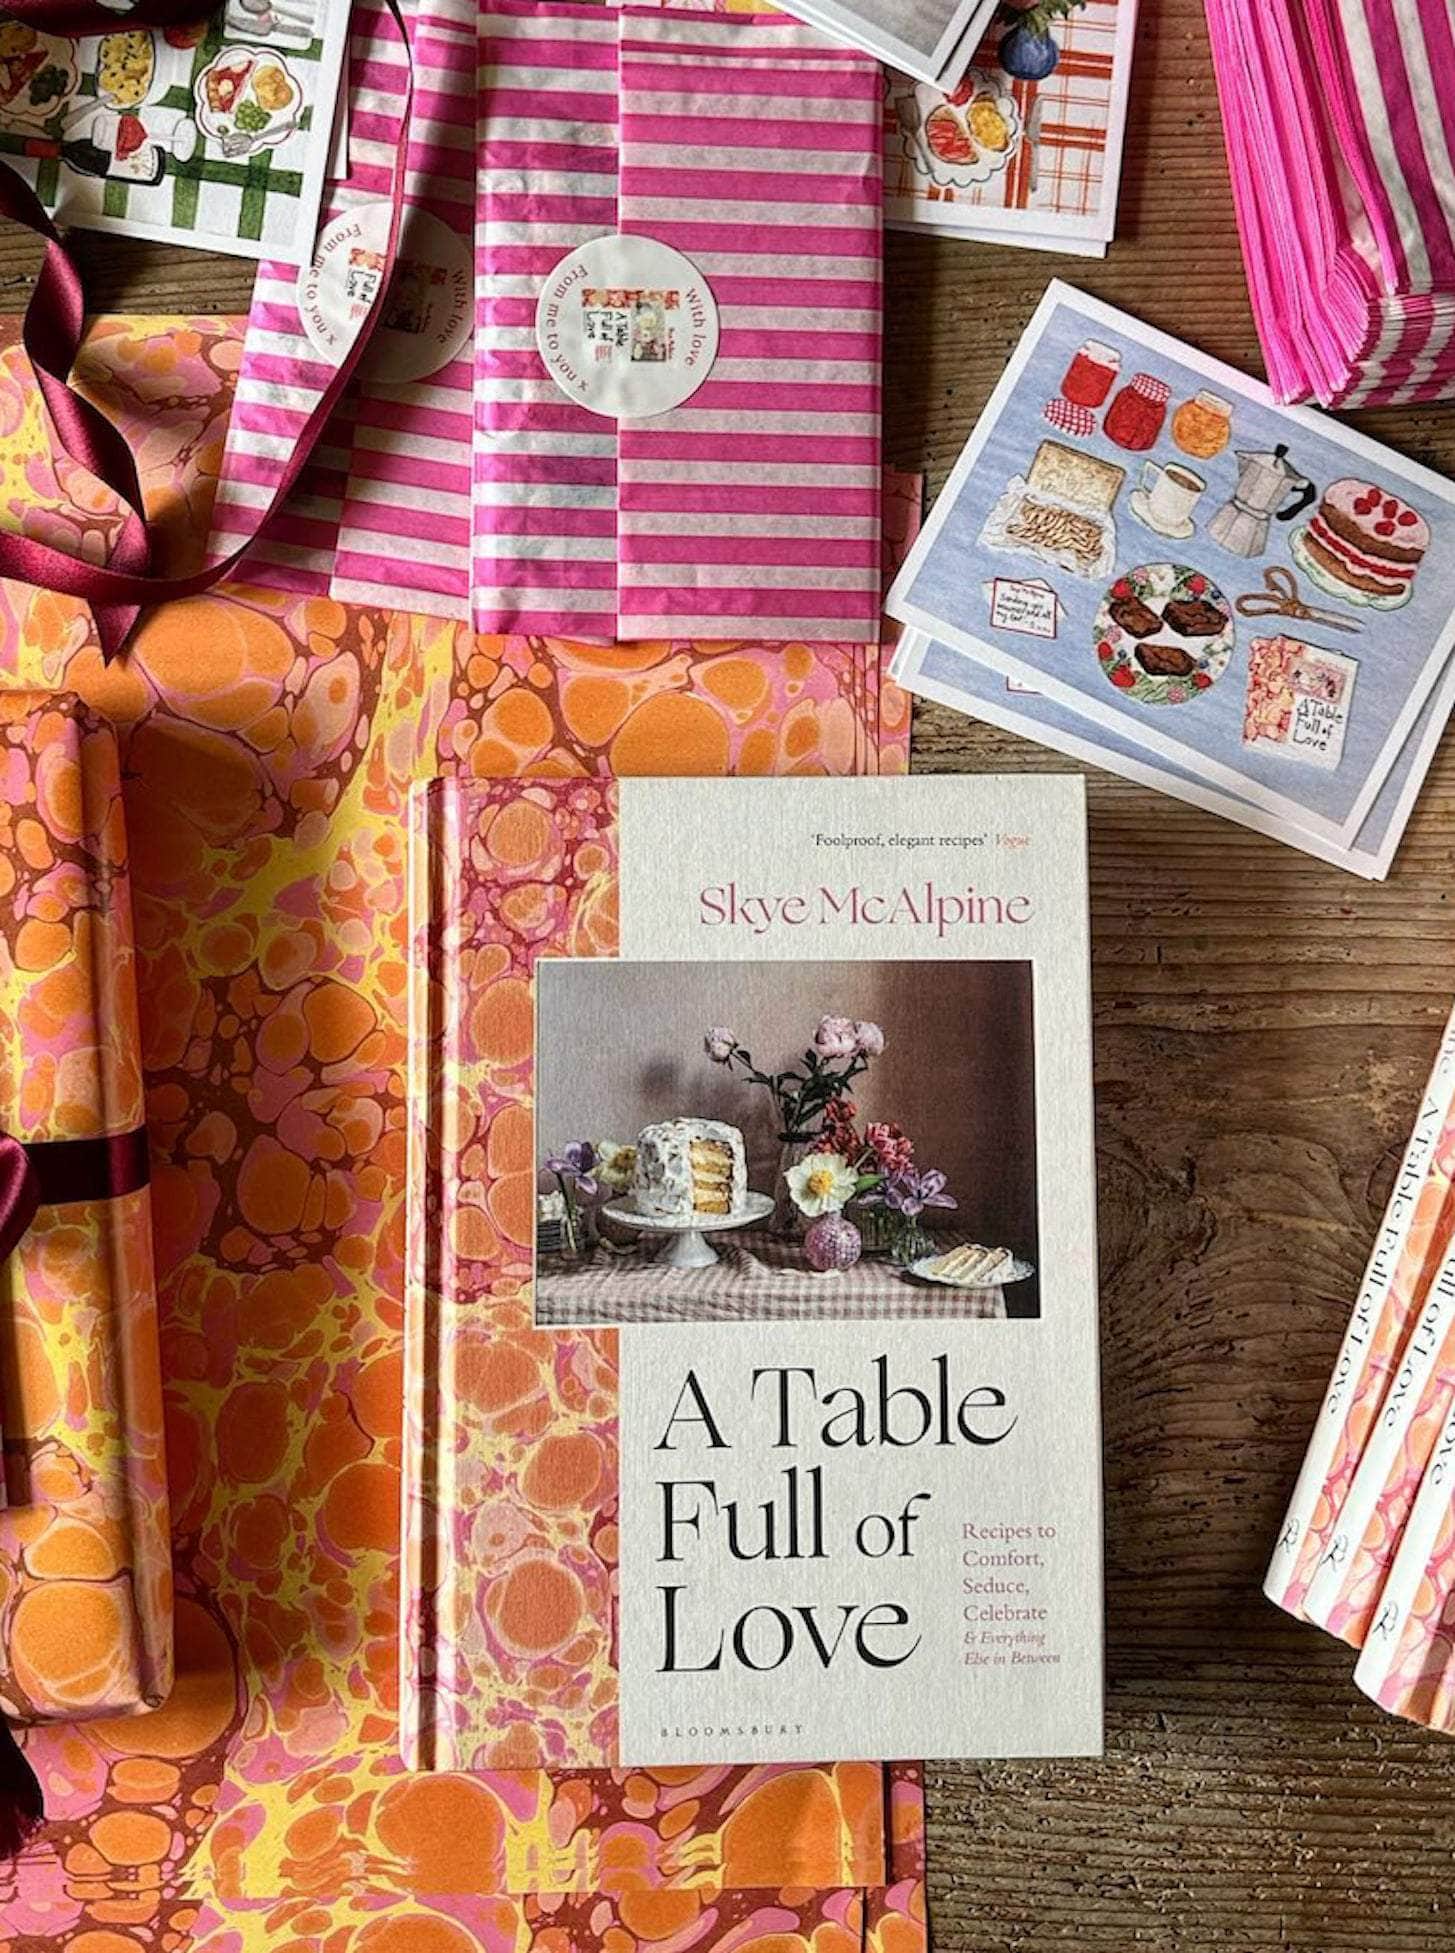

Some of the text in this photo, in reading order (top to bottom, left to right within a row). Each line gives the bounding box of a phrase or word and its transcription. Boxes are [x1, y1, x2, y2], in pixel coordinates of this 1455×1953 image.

[325, 224, 362, 252] From
[310, 254, 325, 278] me
[306, 283, 318, 299] to
[554, 265, 588, 299] From
[305, 305, 327, 334] you
[436, 269, 467, 344] With love
[547, 302, 559, 328] me
[685, 287, 706, 366] With love
[547, 333, 559, 351] to
[550, 354, 577, 382] you
[1297, 698, 1343, 724] A Table
[1293, 728, 1327, 751] Love
[1296, 718, 1321, 735] Full
[888, 834, 935, 849] elegant
[700, 881, 1036, 938] Skye McAlpine
[1391, 1128, 1433, 1220] Table
[1369, 1226, 1400, 1287] Full
[1355, 1292, 1377, 1334] of
[1422, 1303, 1441, 1347] of
[1328, 1335, 1366, 1414] Love
[1385, 1344, 1428, 1427] Love
[653, 1353, 1018, 1450] A Table
[655, 1465, 932, 1561] Full of
[962, 1522, 1056, 1543] Recipes to
[962, 1549, 1045, 1568] Comfort,
[962, 1577, 1030, 1595] Seduce,
[963, 1604, 1048, 1622] Celebrate
[655, 1585, 922, 1673] Love
[964, 1630, 1046, 1647] & Everything
[964, 1651, 1061, 1666] Else in Between
[661, 1725, 802, 1738] BLOOMSBURY
